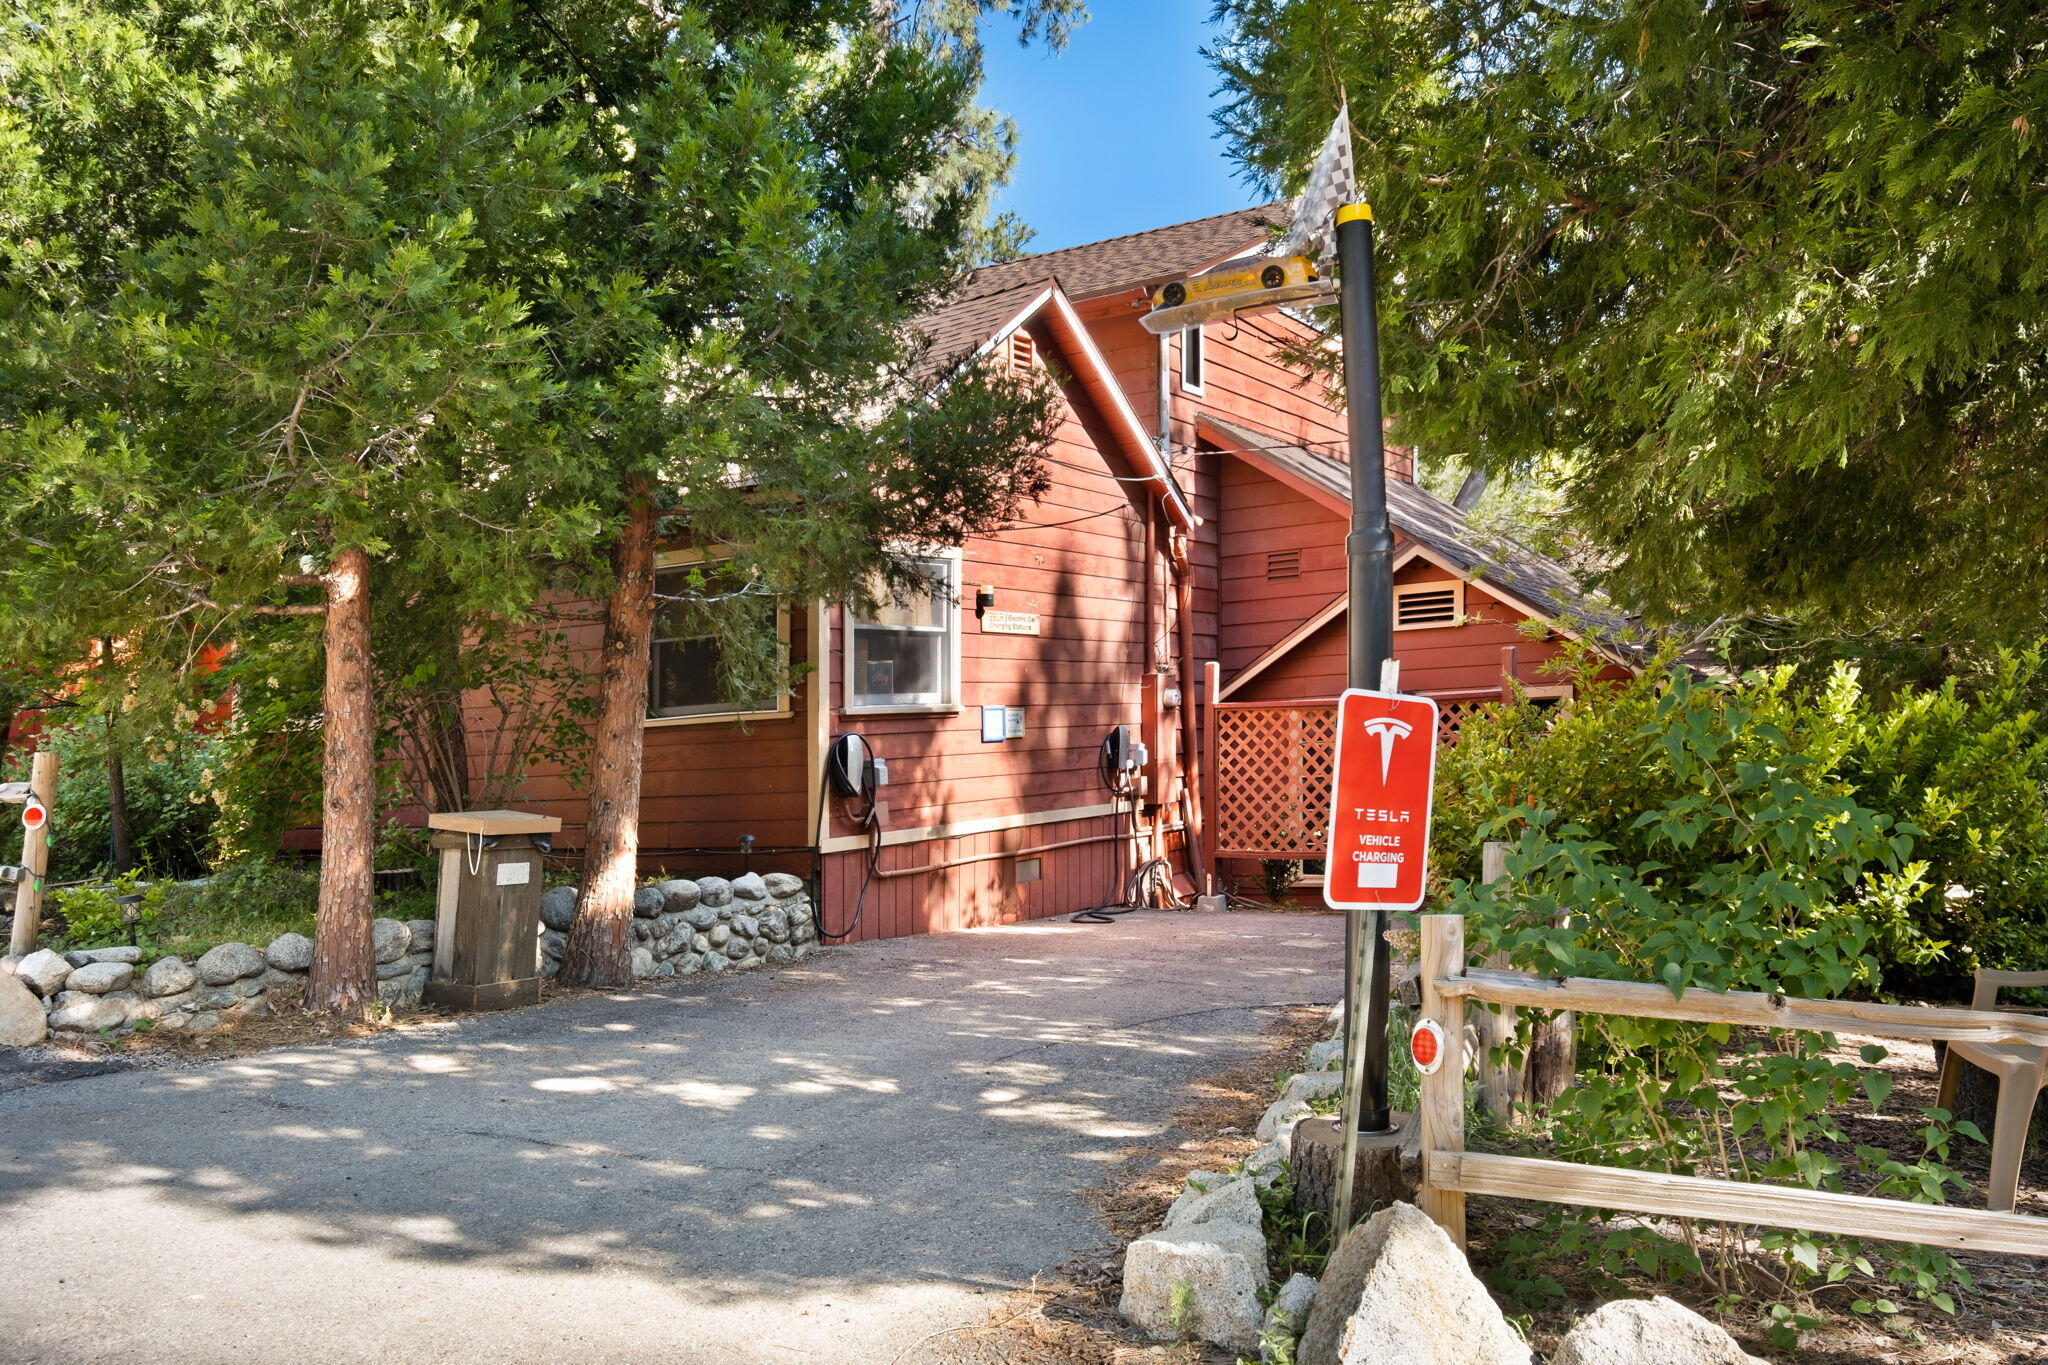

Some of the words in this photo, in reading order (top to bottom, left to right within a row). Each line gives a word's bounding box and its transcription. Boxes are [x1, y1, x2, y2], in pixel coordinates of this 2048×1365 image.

[1354, 808, 1410, 823] TESLA
[1359, 834, 1401, 847] VEHICLE
[1352, 850, 1405, 863] CHARGING
